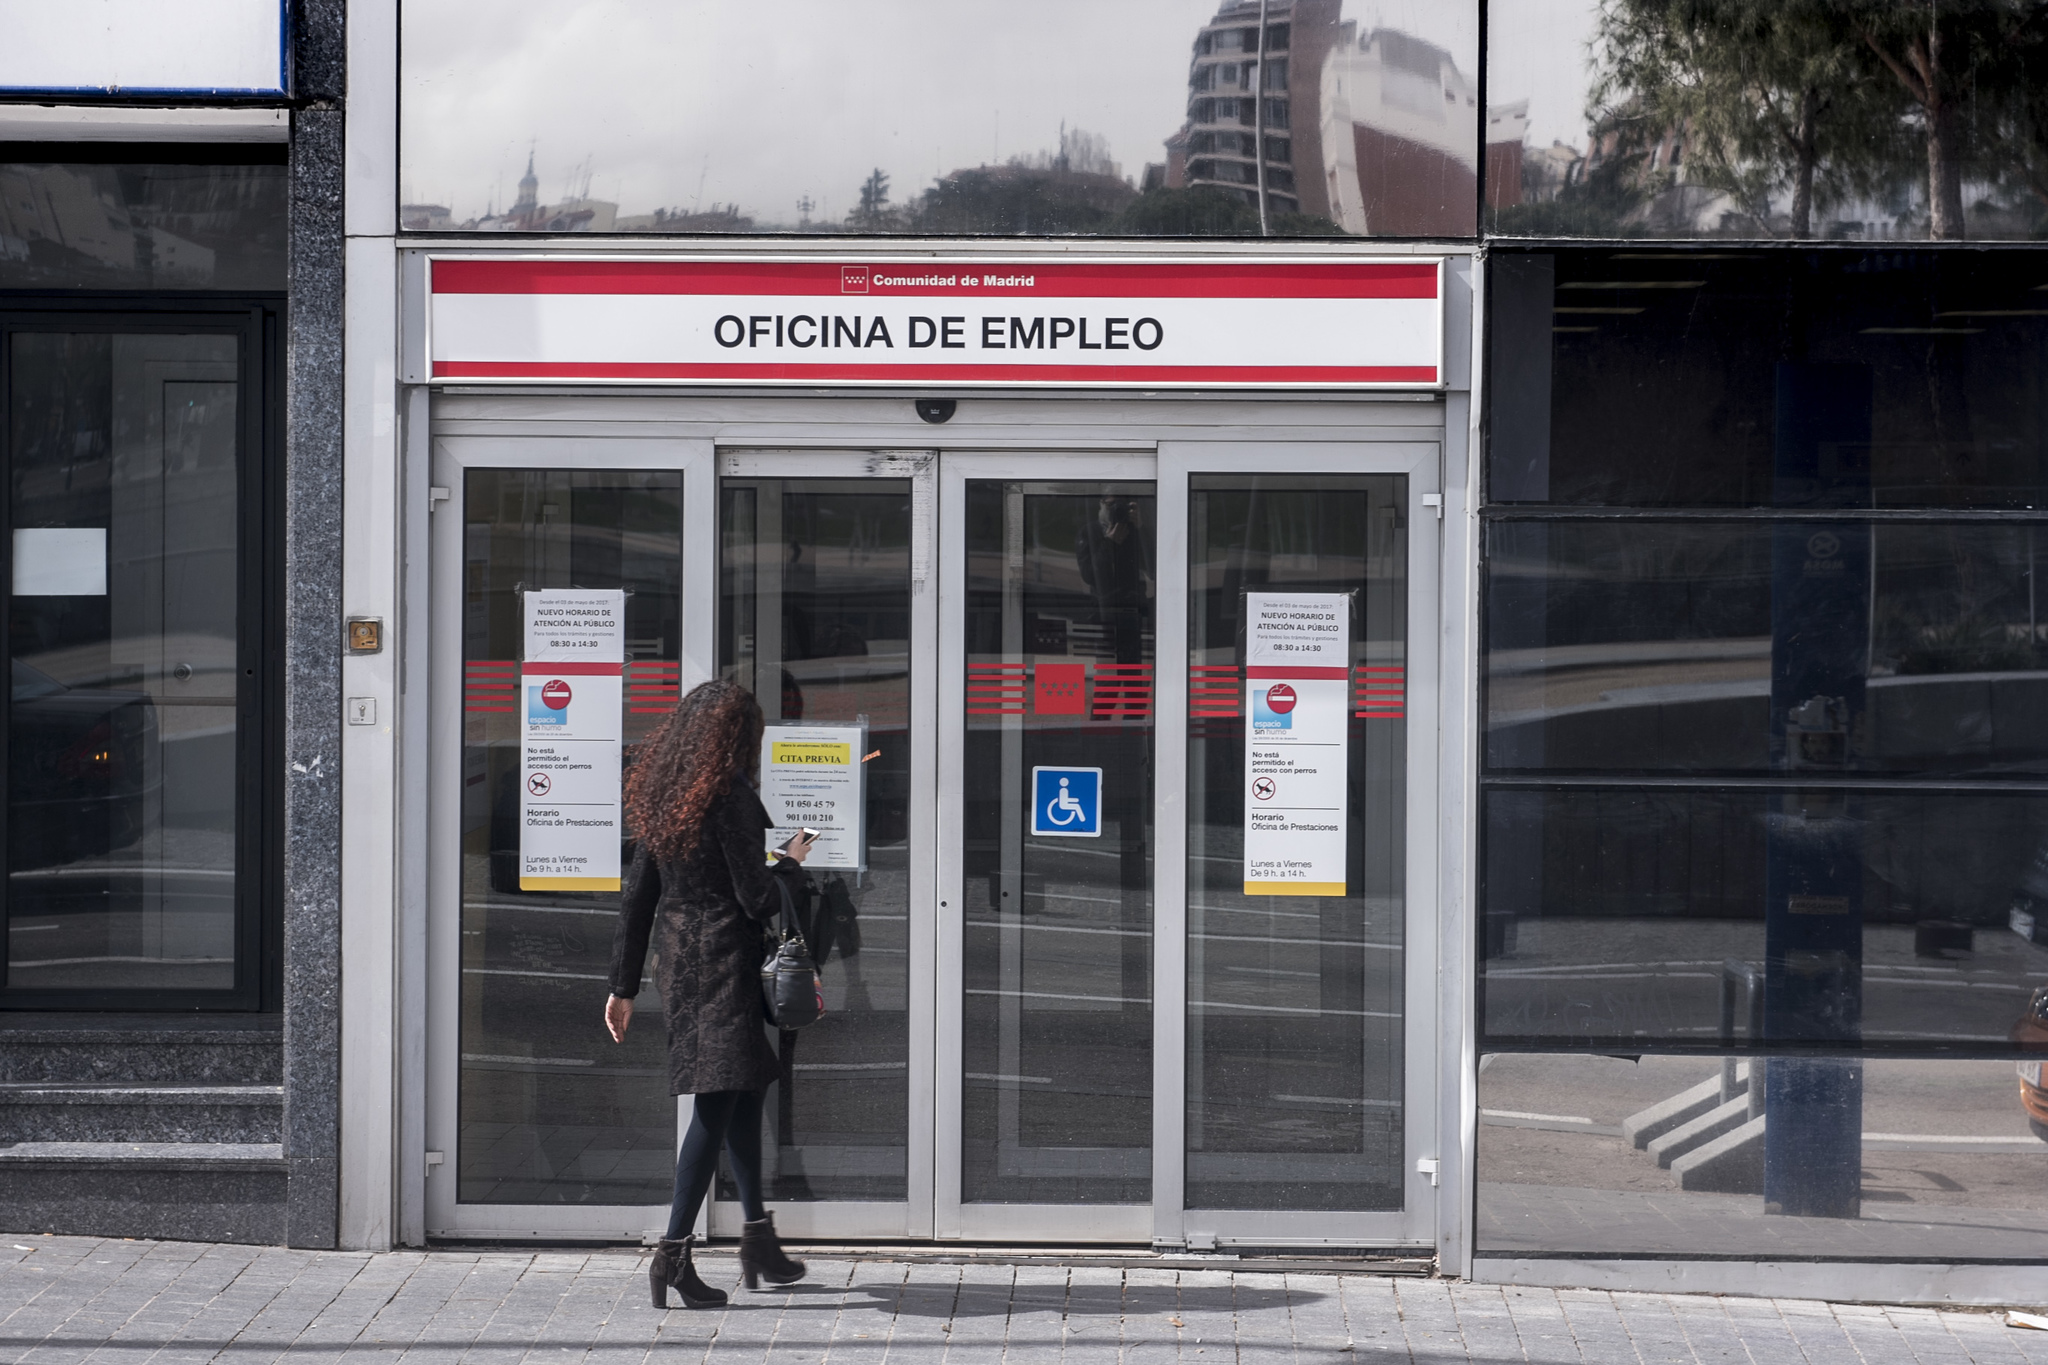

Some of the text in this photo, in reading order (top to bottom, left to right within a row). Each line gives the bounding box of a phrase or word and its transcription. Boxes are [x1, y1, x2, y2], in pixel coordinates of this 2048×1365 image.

[873, 274, 1035, 287] Comunidad de Madrid
[714, 315, 1164, 350] OFICINA DE EMPLEO
[533, 619, 571, 627] ATENCIÓN
[584, 619, 615, 627] PÚBLICO
[1257, 622, 1295, 631] ATENCIÓN
[1307, 623, 1339, 632] PÚBLICO
[578, 640, 598, 648] 14:30
[1301, 644, 1322, 652] 14:30
[529, 716, 557, 724] espacio
[1254, 720, 1282, 728] espacio
[780, 754, 841, 764] CITA PREVIA
[785, 800, 794, 808] 91
[797, 800, 811, 808] 050
[825, 801, 835, 809] 79
[527, 809, 560, 817] Horario
[1251, 813, 1284, 821] Horario
[786, 813, 834, 822] 901 010 210
[527, 818, 614, 827] Oficina de Prestaciones
[1251, 822, 1338, 832] Oficina de Prestaciones
[526, 855, 550, 863] Lunes
[558, 855, 588, 864] Viernes
[1250, 860, 1275, 868] Lunes
[1283, 860, 1312, 868] Viernes
[526, 865, 537, 873] De
[539, 865, 544, 873] 9
[546, 865, 554, 873] h.
[563, 865, 572, 873] 14
[574, 865, 582, 873] h.
[1250, 869, 1262, 877] De
[1263, 869, 1269, 877] 9
[1270, 869, 1278, 877] h.
[1298, 869, 1307, 877] h.
